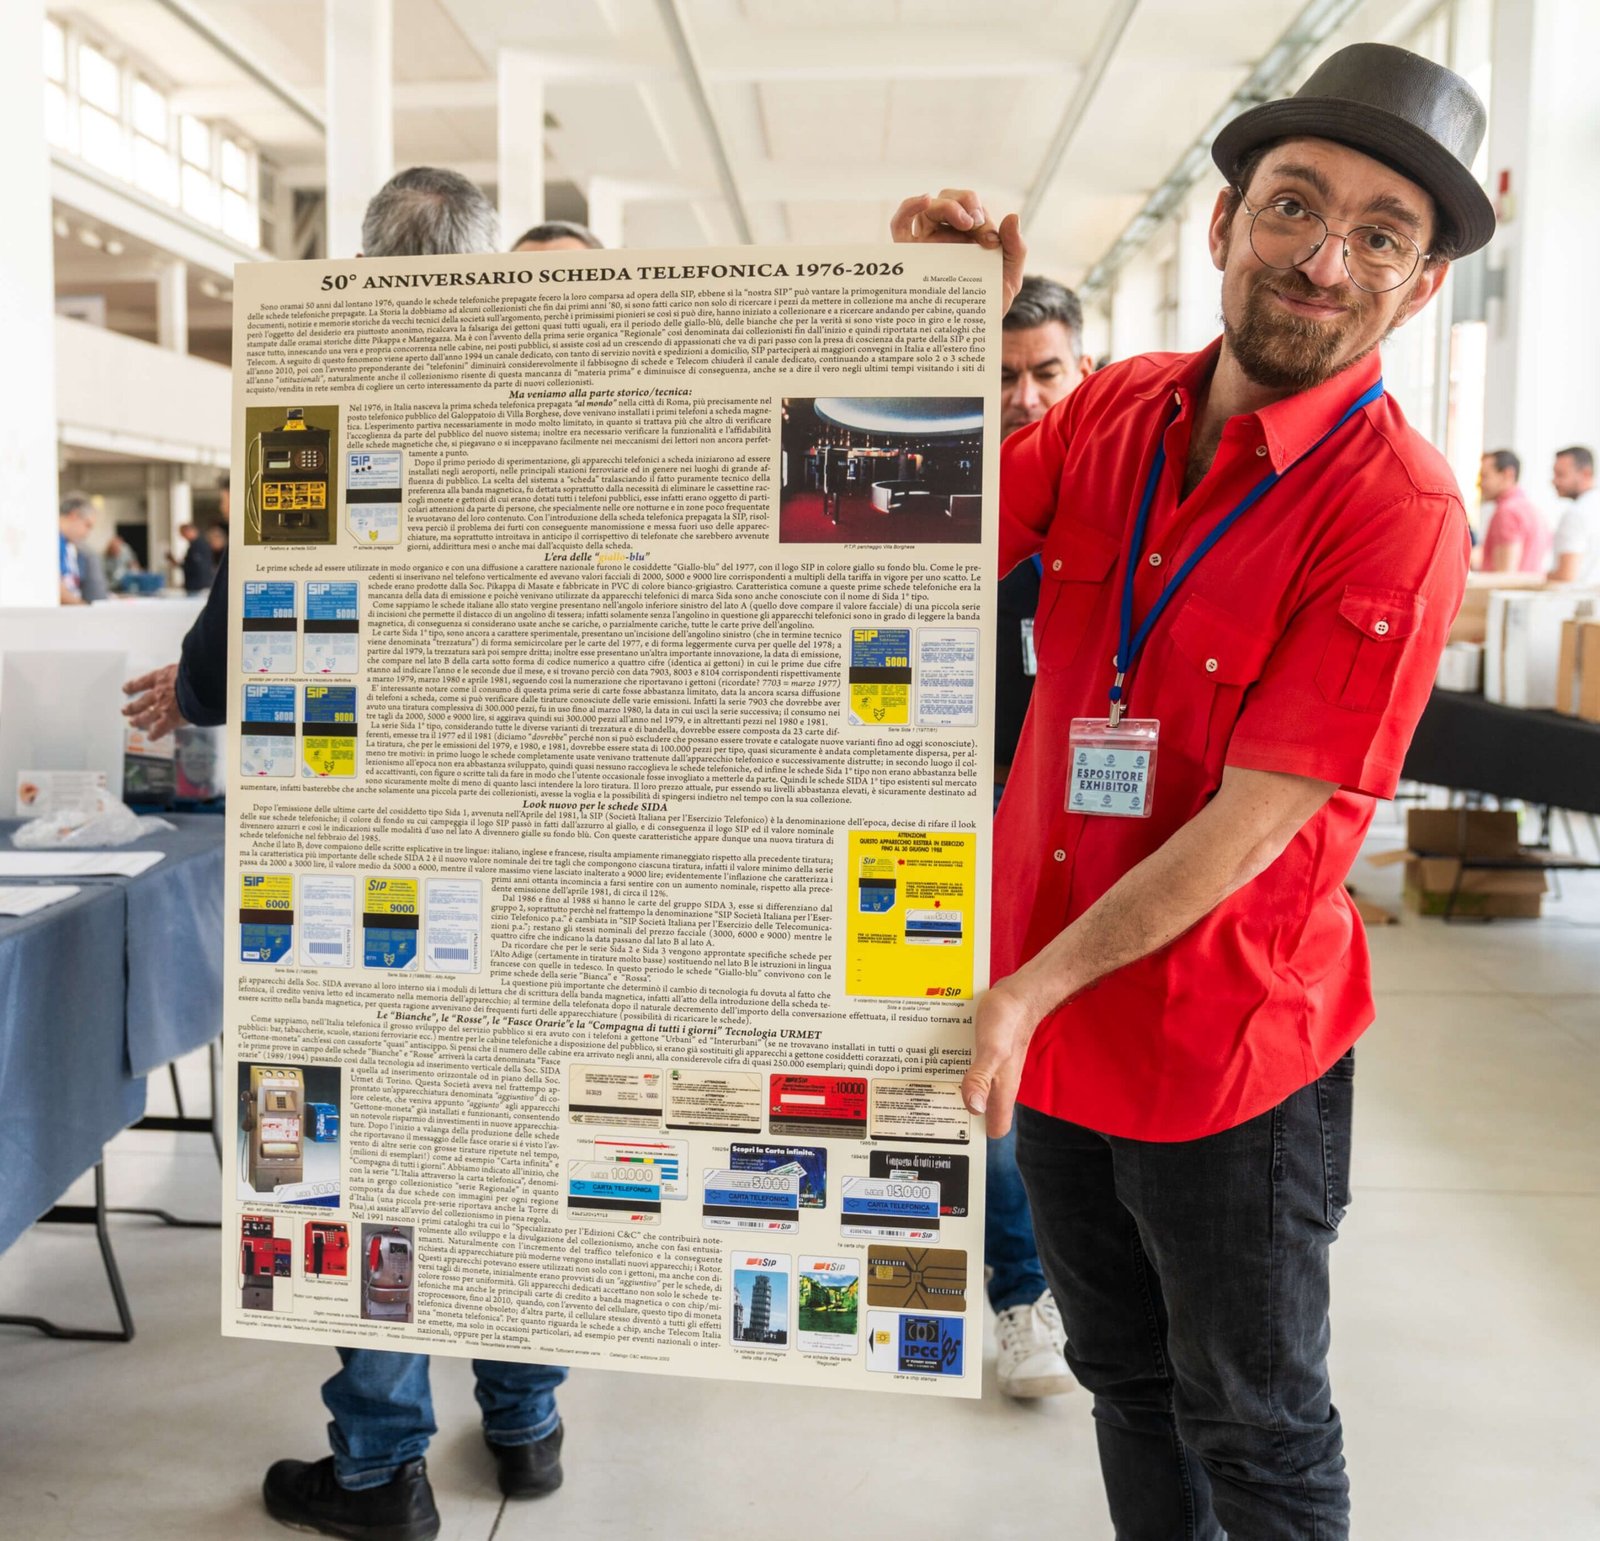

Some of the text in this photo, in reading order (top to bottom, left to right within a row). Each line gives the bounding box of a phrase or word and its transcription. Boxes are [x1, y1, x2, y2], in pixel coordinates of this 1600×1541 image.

[320, 260, 903, 291] 50° ANNIVERSARIO SCHEDA TELEFONICA 1976-2026
[246, 384, 304, 395] acquisto/vendita
[306, 384, 313, 392] in
[330, 383, 355, 391] sembra
[366, 382, 393, 392] cogliere
[426, 380, 481, 389] interessamento
[494, 380, 512, 389] parte
[514, 379, 522, 387] di
[546, 378, 593, 386] collezionisti.
[508, 386, 692, 400] Ma veniamo alla parte storico/tecnica:
[351, 456, 370, 466] SIP
[545, 553, 567, 561] L'era
[570, 552, 592, 561] delle
[246, 584, 267, 594] SIP
[309, 584, 330, 595] SIP
[273, 608, 293, 618] 5000
[336, 609, 356, 618] 5000
[854, 630, 878, 641] SIP
[885, 657, 907, 667] 5000
[247, 686, 268, 697] SIP
[307, 687, 328, 698] SIP
[1077, 769, 1144, 781] ESPOSITORE
[1080, 780, 1138, 793] EXHIBITOR
[522, 799, 546, 808] Look
[579, 803, 595, 812] per
[597, 801, 605, 810] le
[607, 801, 638, 811] schede
[640, 802, 667, 811] SIDA
[239, 830, 380, 842] schede telefoniche nel febbraio del 1985.
[244, 876, 264, 886] SIP
[491, 884, 511, 892] dente
[513, 885, 550, 893] emissione
[552, 886, 588, 896] dell'aprile
[591, 887, 611, 897] 1981,
[622, 888, 640, 896] circa
[650, 889, 667, 897] 12%.
[266, 900, 289, 908] 6000
[390, 904, 414, 913] 9000
[376, 1010, 822, 1039] Le “Bianche”, le “Rosse”, le “Fasce Orarie”e la “Compagna di tutti i giorni” Tecnologia URMET
[732, 1146, 755, 1154] Scopri
[786, 1148, 815, 1156] infinita.
[611, 1168, 653, 1181] 10.000
[752, 1176, 790, 1190] 5.000
[614, 1185, 652, 1193] TELEFONICA
[887, 1185, 930, 1199] 15.000
[751, 1194, 789, 1202] TELEFONICA
[417, 1326, 530, 1344] nazionali, oppure per la stampa.
[904, 1345, 939, 1357] IPCC
